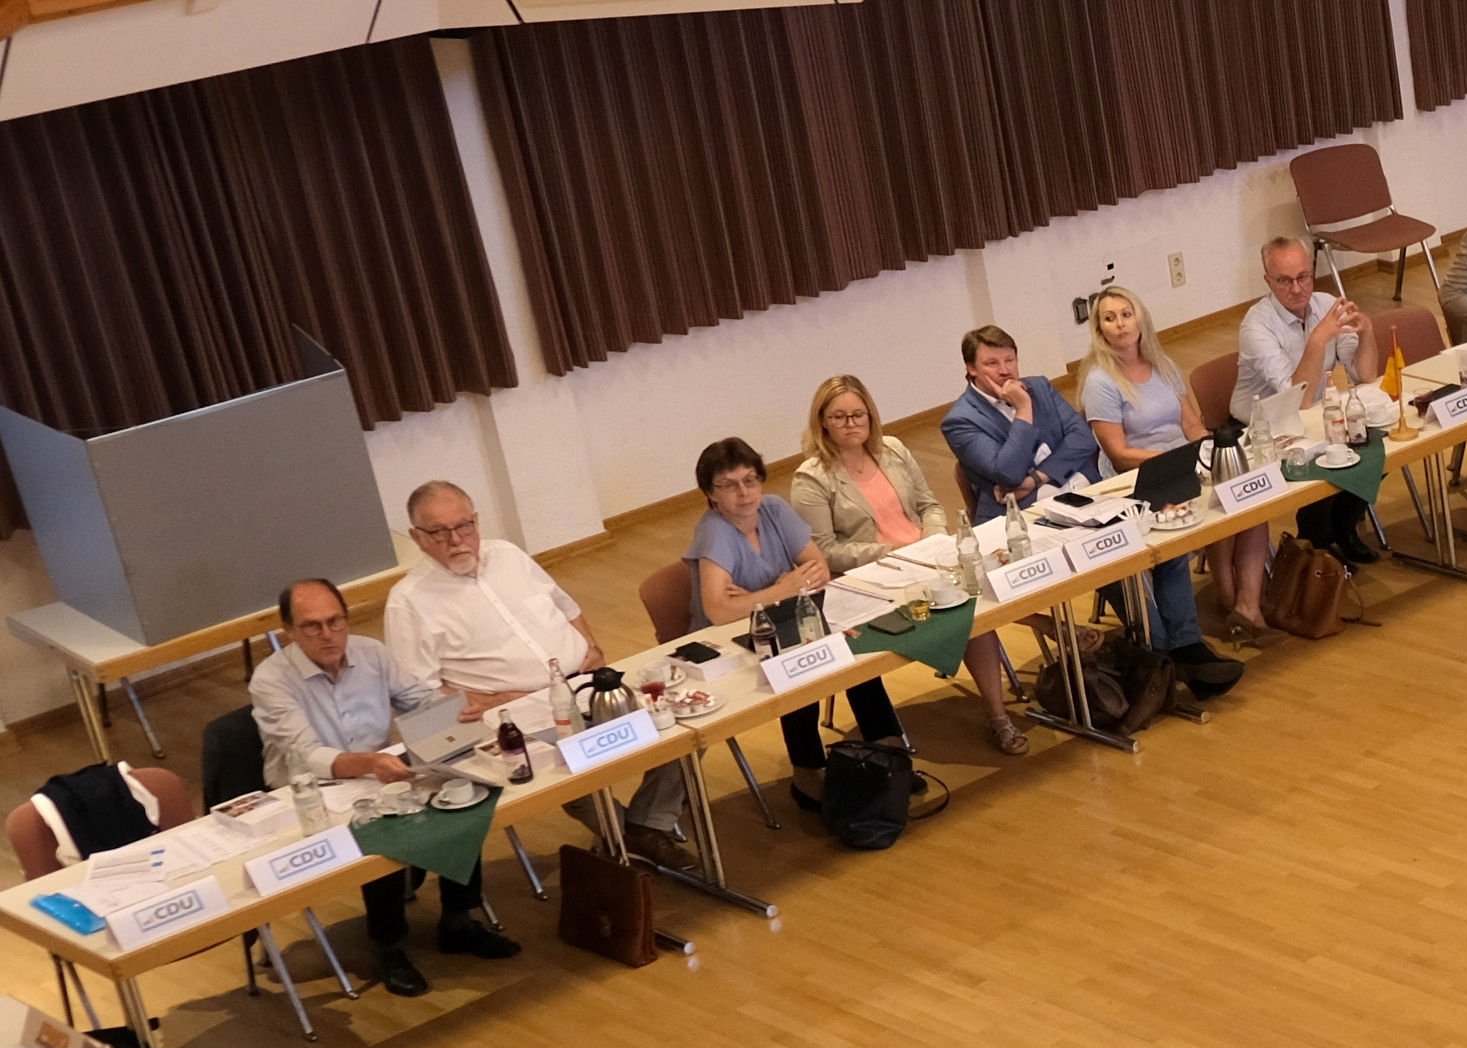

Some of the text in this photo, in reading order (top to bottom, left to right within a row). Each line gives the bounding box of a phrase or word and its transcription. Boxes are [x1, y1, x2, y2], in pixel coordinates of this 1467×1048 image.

[1242, 477, 1266, 494] CDU
[1096, 533, 1122, 551] CDU
[1019, 562, 1046, 580] CDU
[797, 649, 827, 669] CDU
[596, 728, 629, 748] CDU
[290, 845, 327, 868] CDU
[154, 897, 193, 920] CDU
